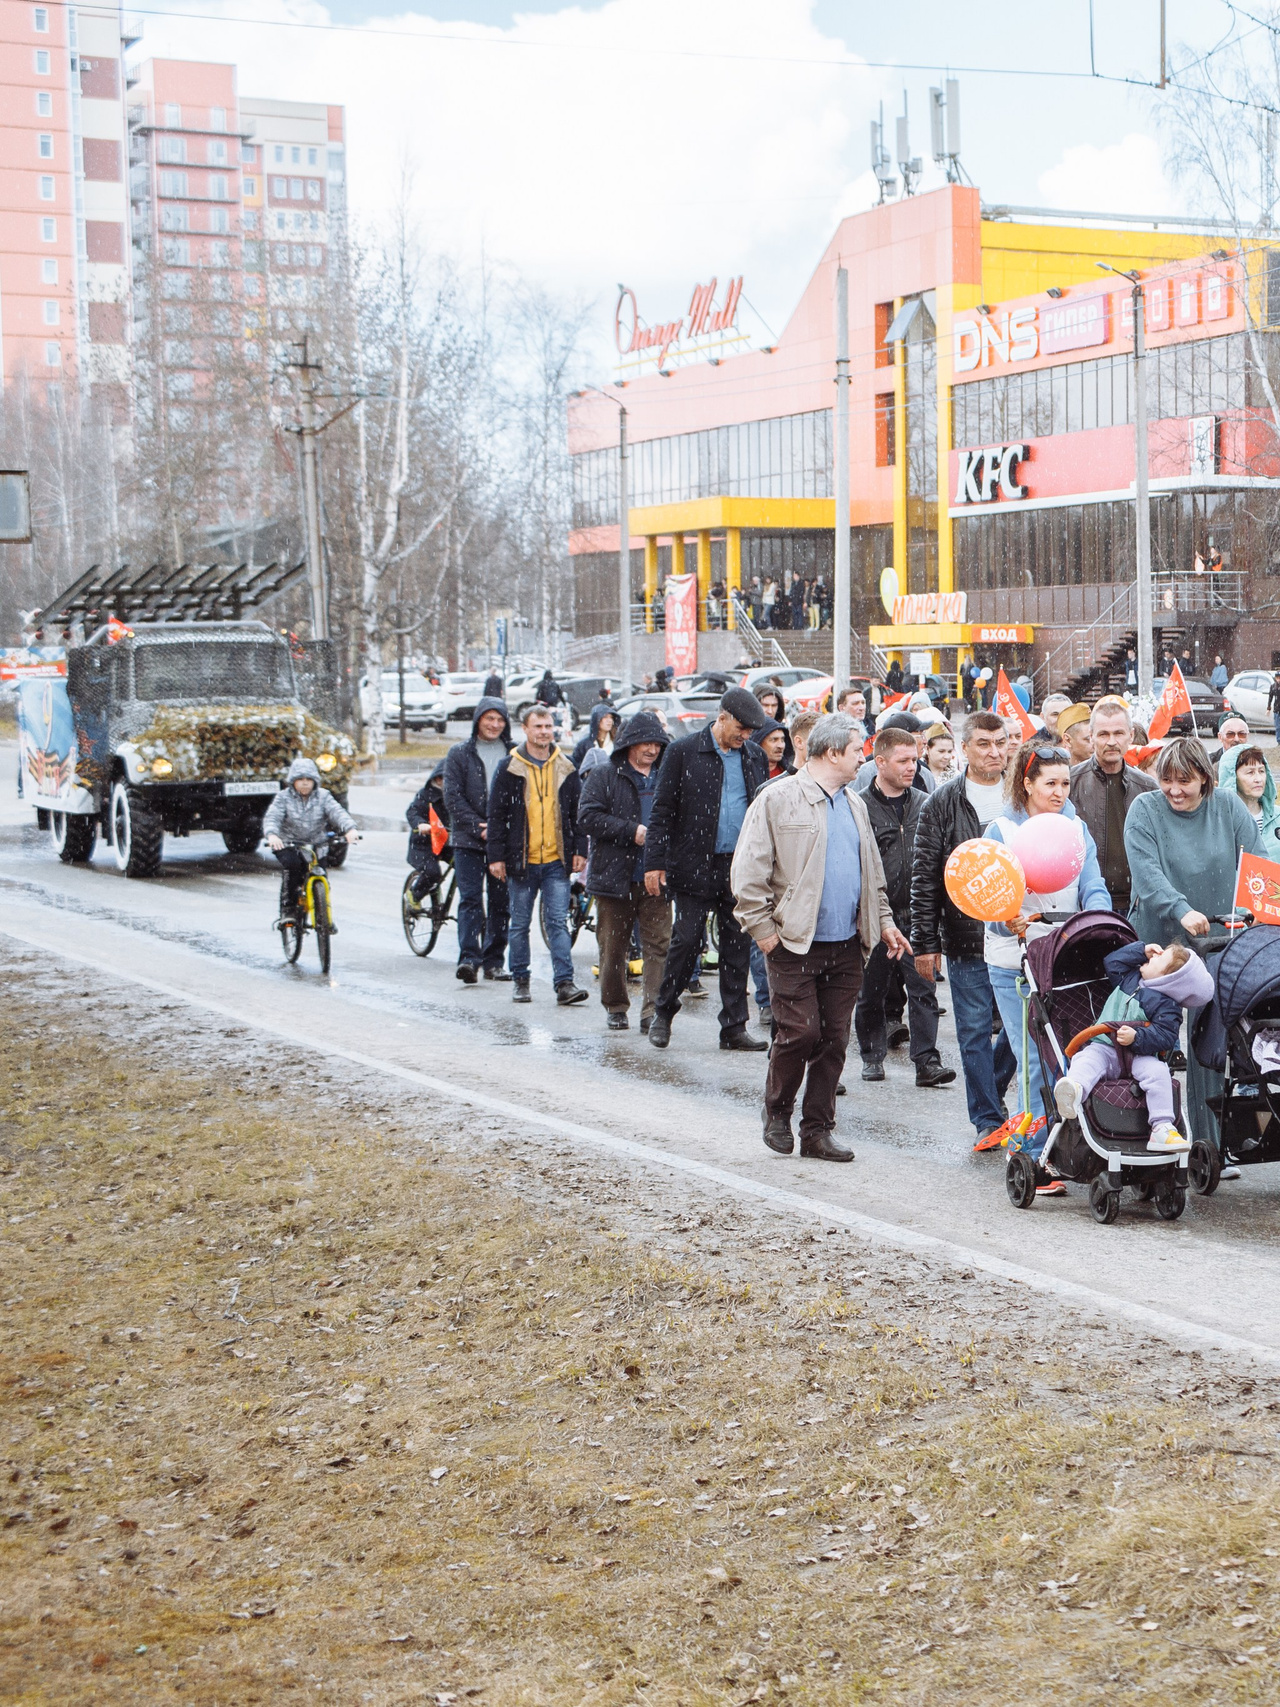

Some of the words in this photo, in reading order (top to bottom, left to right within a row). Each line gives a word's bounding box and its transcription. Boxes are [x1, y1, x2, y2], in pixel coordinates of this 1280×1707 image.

[954, 306, 1039, 373] DNS
[1045, 303, 1098, 341] ГИПЕР
[954, 443, 1026, 503] KFC
[980, 628, 1018, 642] ВХОД
